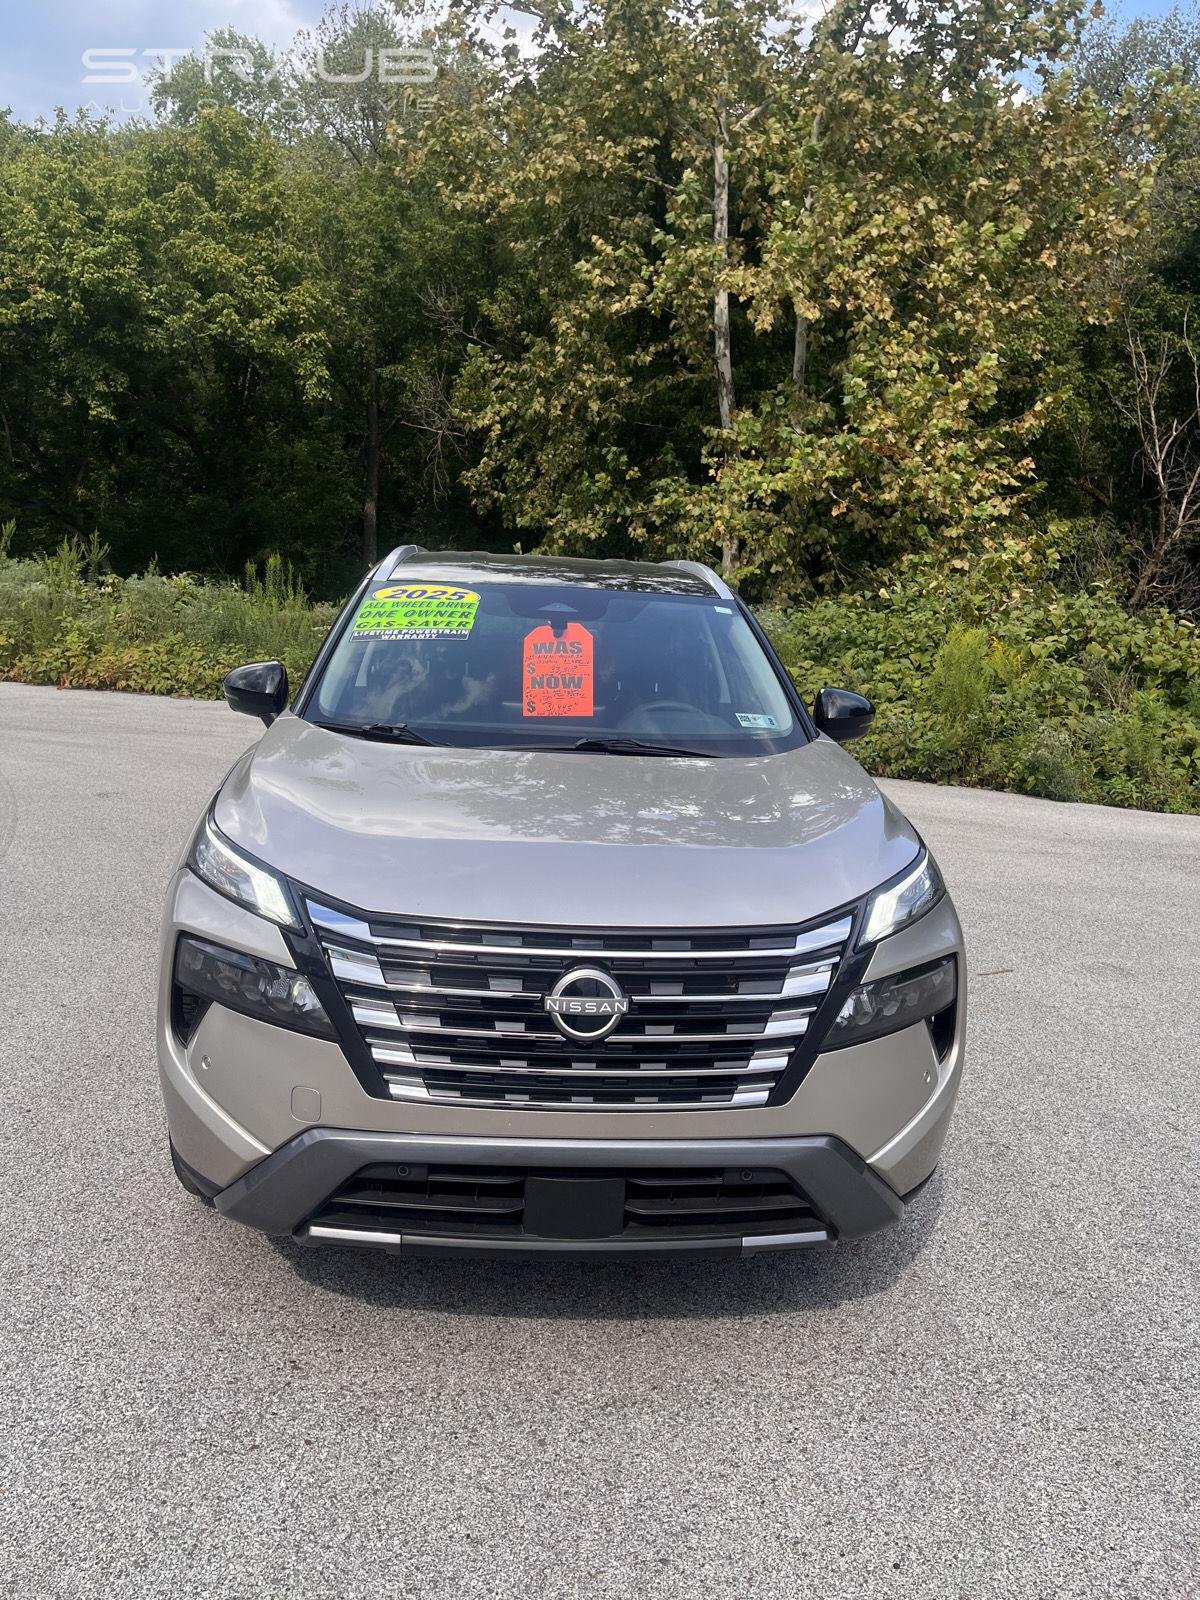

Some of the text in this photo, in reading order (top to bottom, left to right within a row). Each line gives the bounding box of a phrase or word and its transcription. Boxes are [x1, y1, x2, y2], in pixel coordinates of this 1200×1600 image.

[384, 589, 471, 600] 2025
[364, 601, 387, 609] ALL
[435, 601, 477, 610] DRIVE
[358, 610, 472, 619] ONE OWNER
[355, 620, 472, 629] GAS-SAVER
[353, 629, 399, 637] LIFETIME
[533, 641, 583, 655] WAS
[531, 674, 583, 689] NOW
[527, 700, 536, 714] $
[546, 1000, 627, 1013] NISSAN
